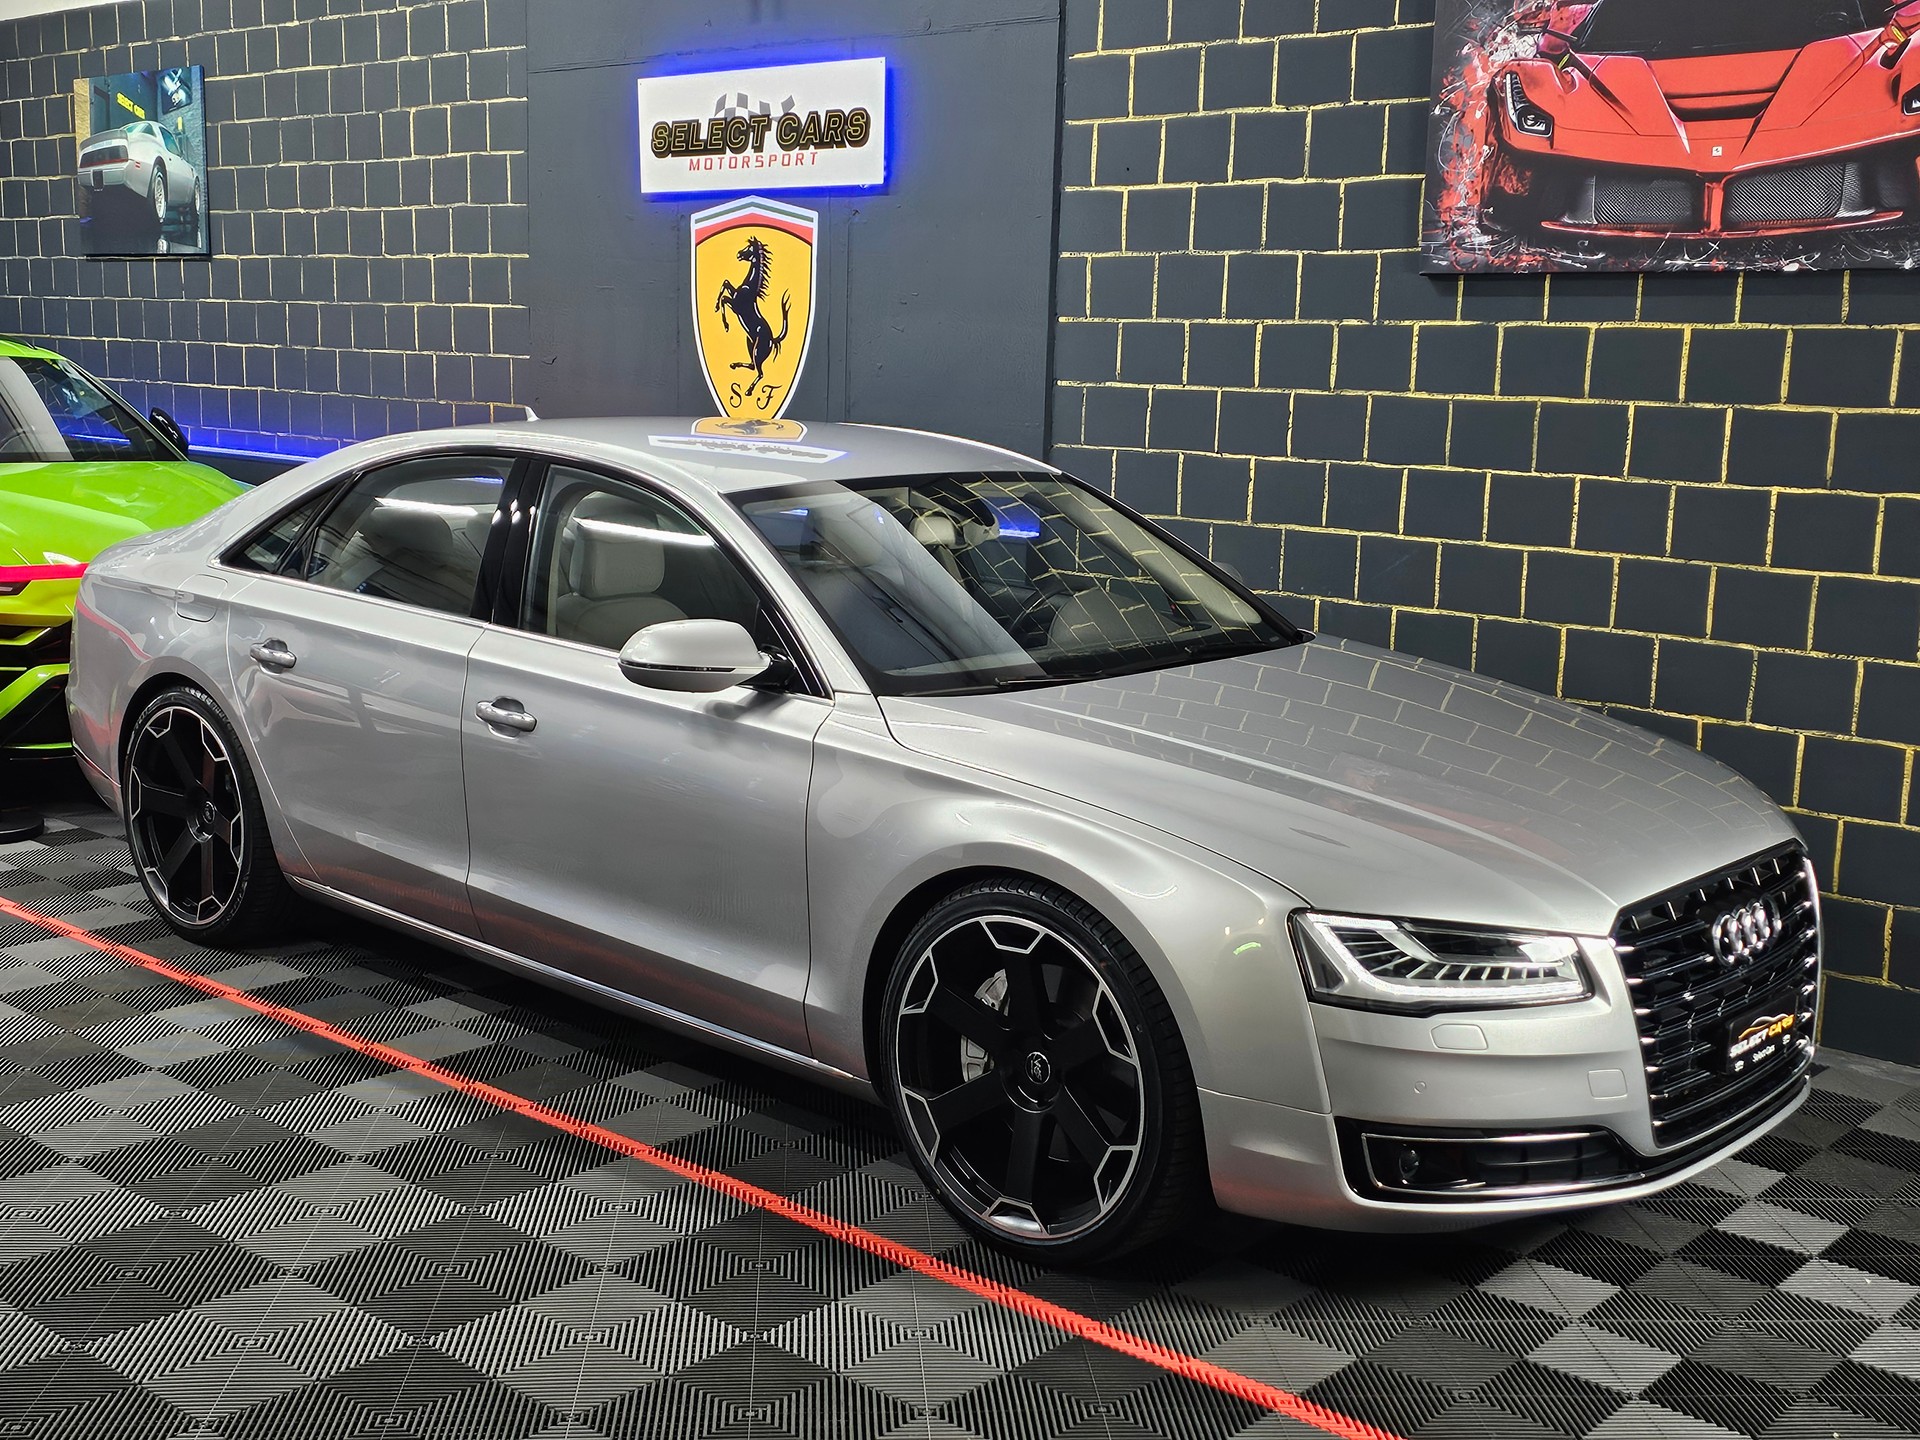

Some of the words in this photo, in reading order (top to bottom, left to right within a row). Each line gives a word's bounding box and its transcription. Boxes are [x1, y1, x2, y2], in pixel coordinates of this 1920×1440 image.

[651, 114, 771, 158] SELECT
[776, 106, 871, 151] CARS
[689, 152, 818, 171] MOTORSPORT
[729, 382, 742, 408] S
[756, 384, 782, 410] F
